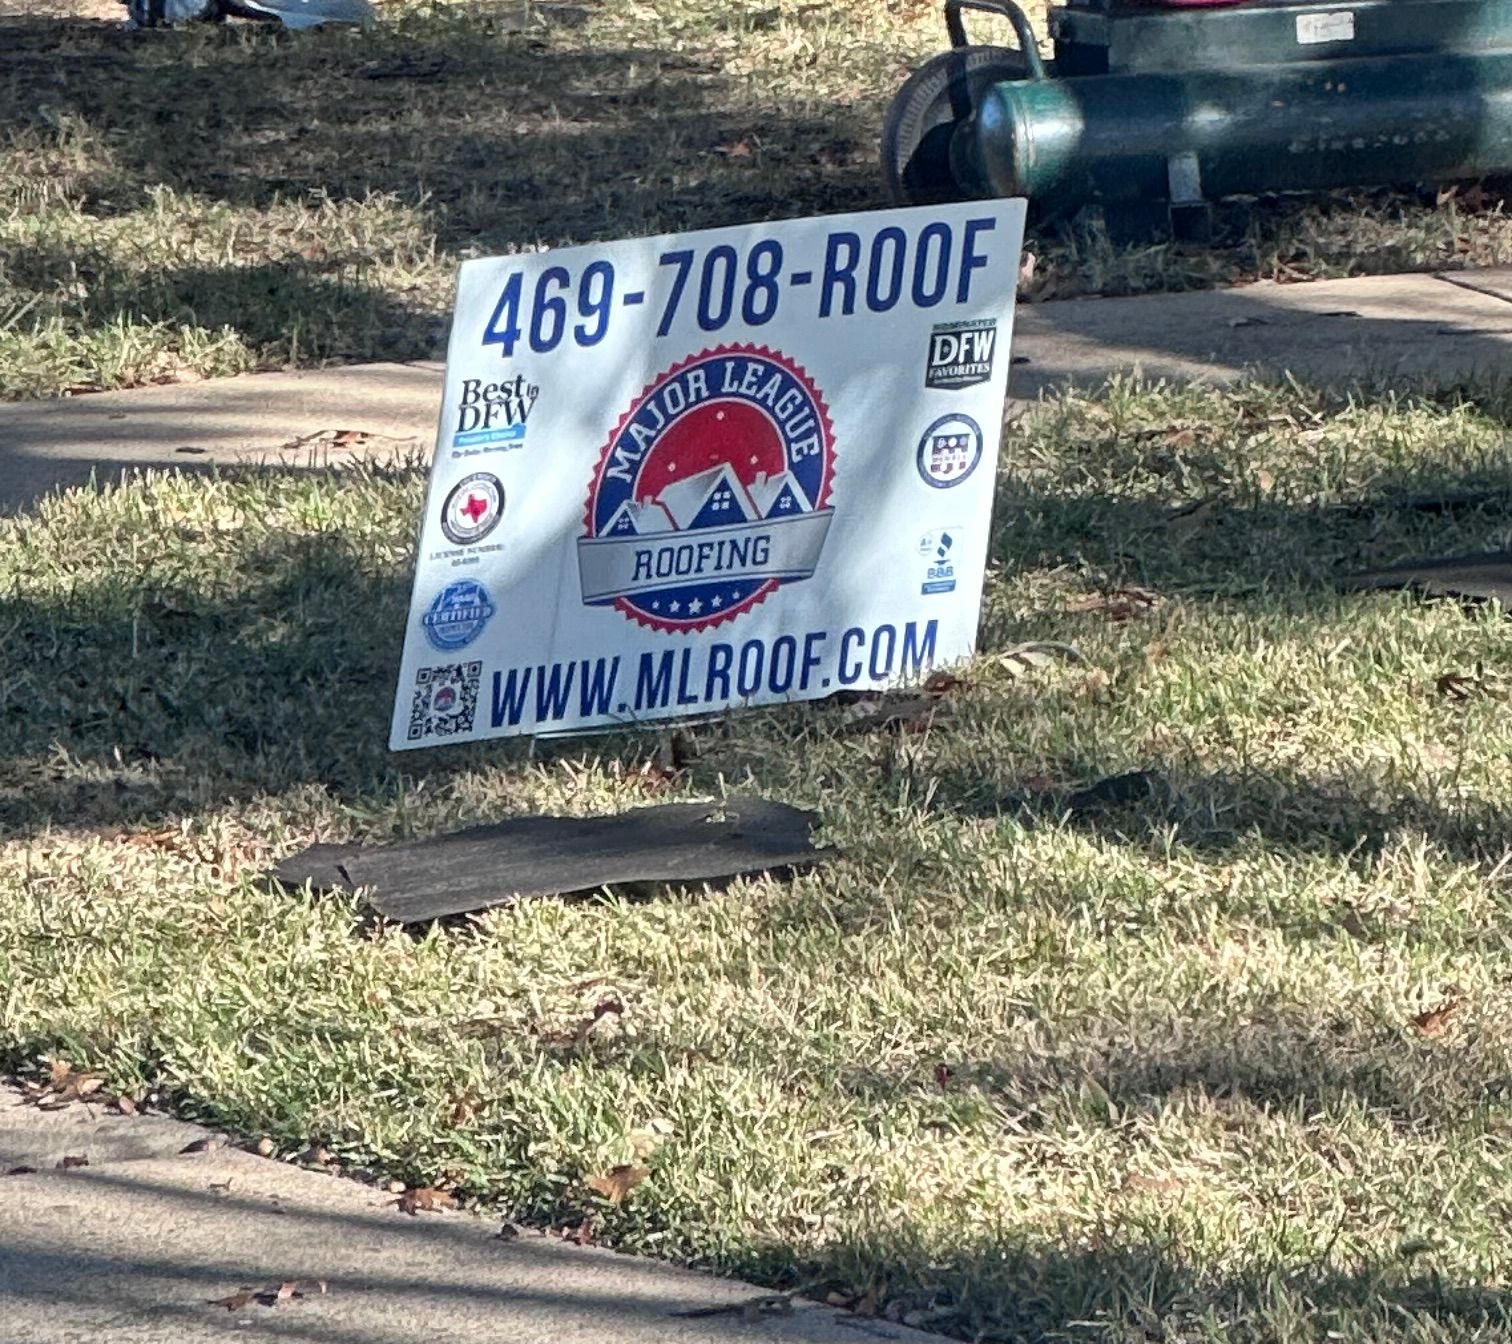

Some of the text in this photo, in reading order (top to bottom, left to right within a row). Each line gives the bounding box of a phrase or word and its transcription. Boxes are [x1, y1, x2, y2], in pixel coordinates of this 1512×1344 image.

[482, 216, 997, 358] 469-708-ROOF
[931, 330, 995, 366] DFW
[462, 374, 526, 404] Best
[455, 396, 537, 433] DFW
[607, 368, 710, 483] MAJOR
[721, 361, 820, 463] LEAGUE
[632, 534, 771, 581] ROOFING
[491, 619, 939, 729] WWW.MLROOF.COM
